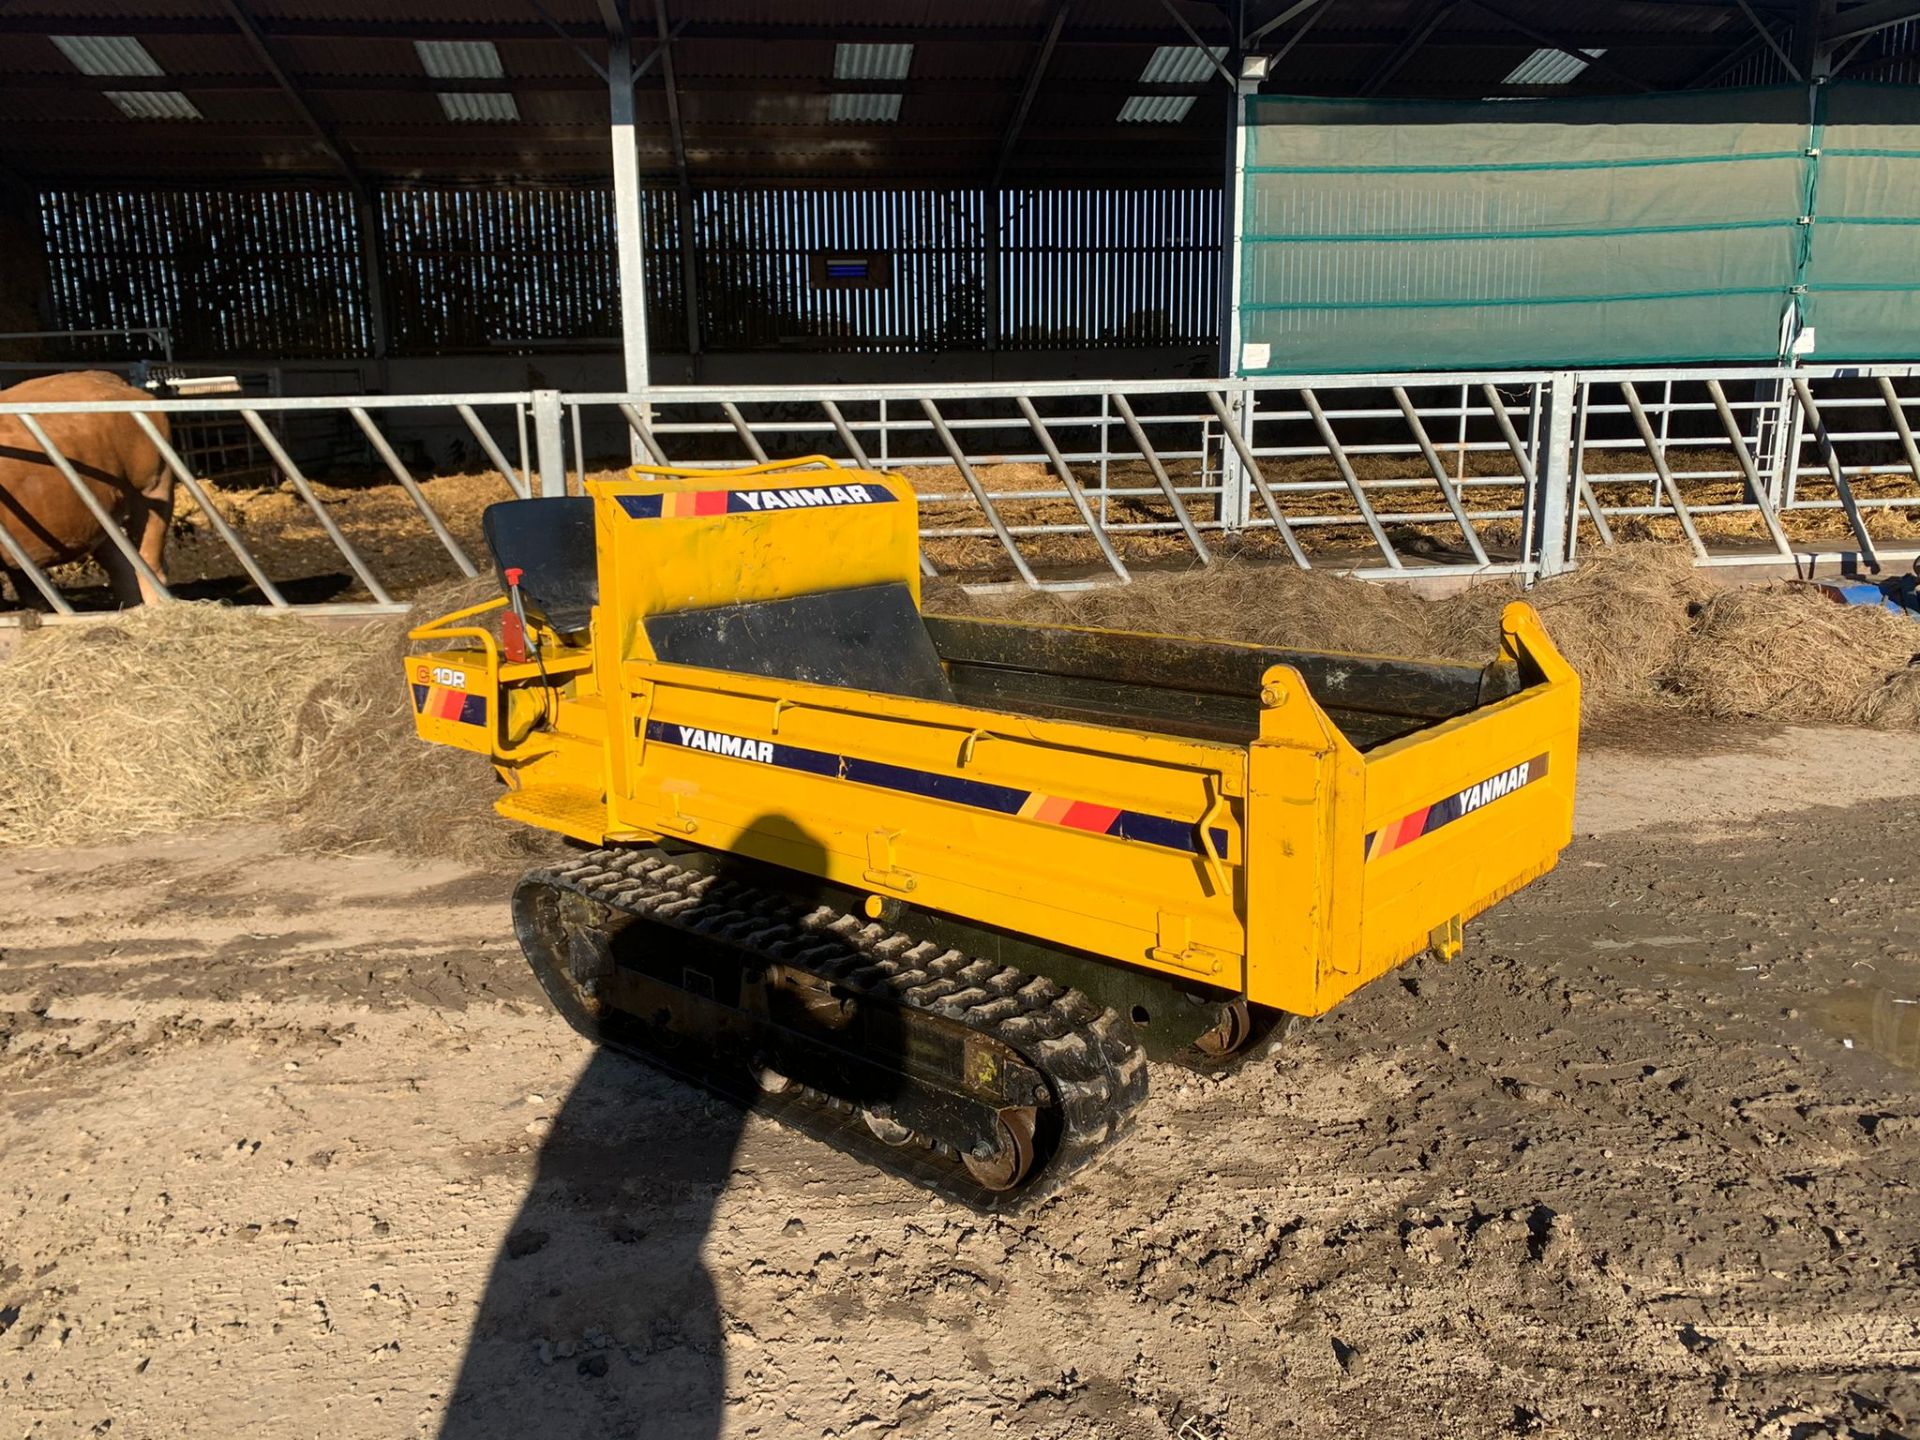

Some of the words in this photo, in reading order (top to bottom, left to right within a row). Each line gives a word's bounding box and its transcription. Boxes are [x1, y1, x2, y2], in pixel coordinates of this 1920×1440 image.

[735, 484, 872, 510] YANMAR
[679, 726, 774, 763] YANMAR
[1459, 761, 1529, 815] YANMAR
